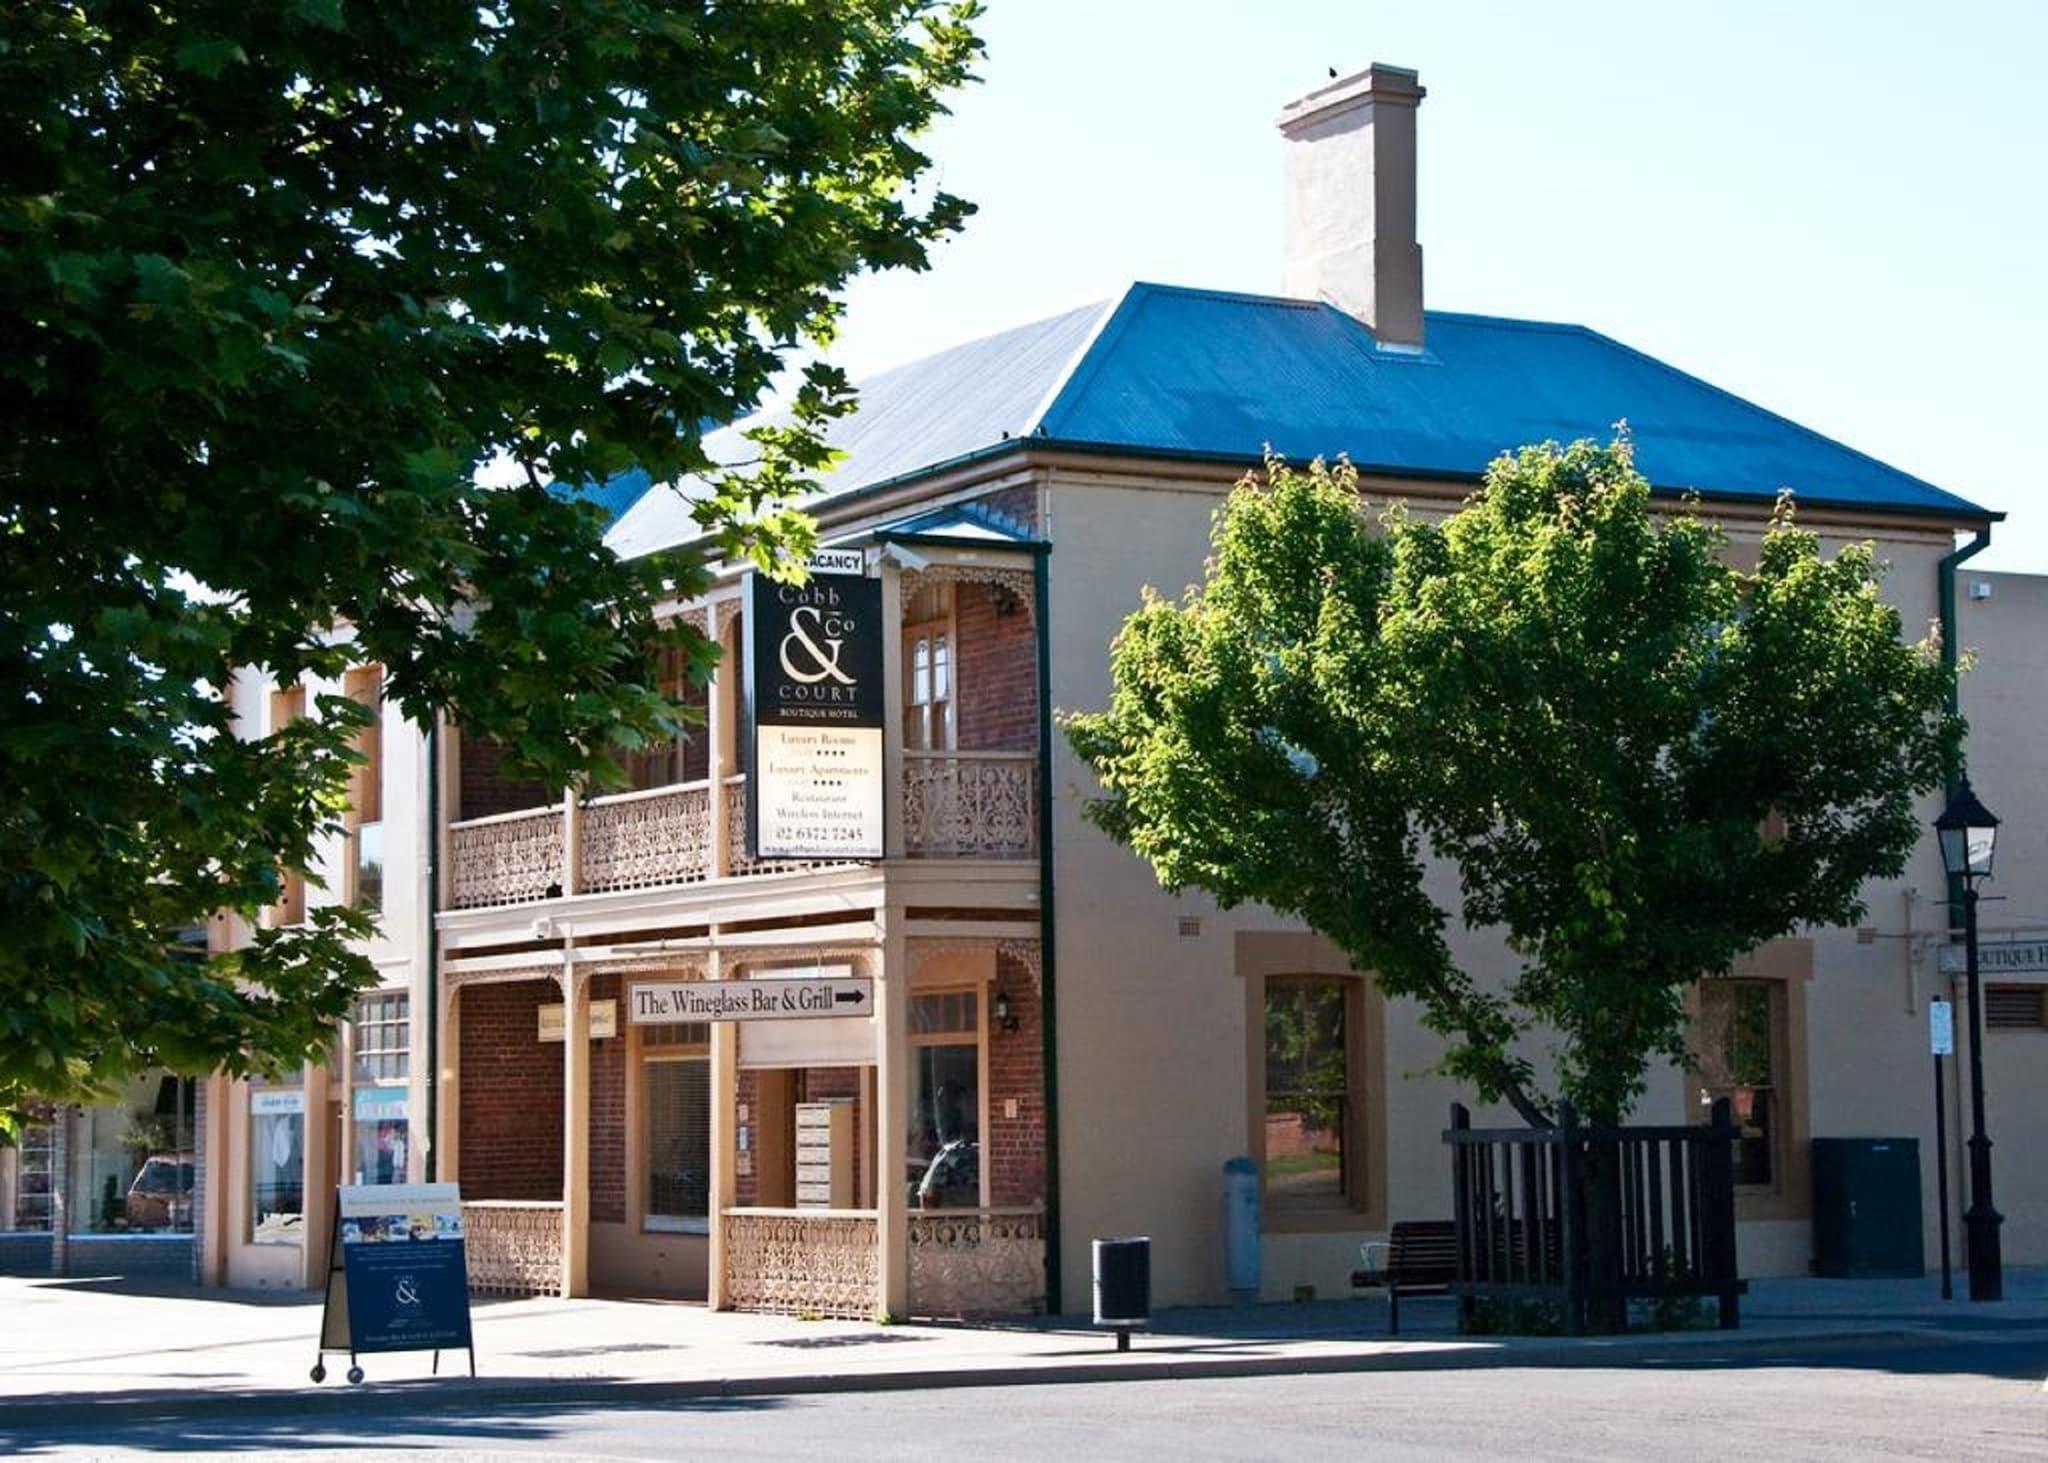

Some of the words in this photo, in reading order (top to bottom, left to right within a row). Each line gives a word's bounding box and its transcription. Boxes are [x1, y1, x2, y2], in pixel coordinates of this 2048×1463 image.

[780, 606, 857, 684] &
[825, 617, 855, 638] Co
[779, 685, 857, 701] COURT
[829, 709, 858, 719] HOTEL
[636, 990, 668, 1014] The
[672, 988, 748, 1017] Wineglass
[752, 988, 777, 1012] Bar
[782, 987, 796, 1010] &
[799, 986, 833, 1010] Grill
